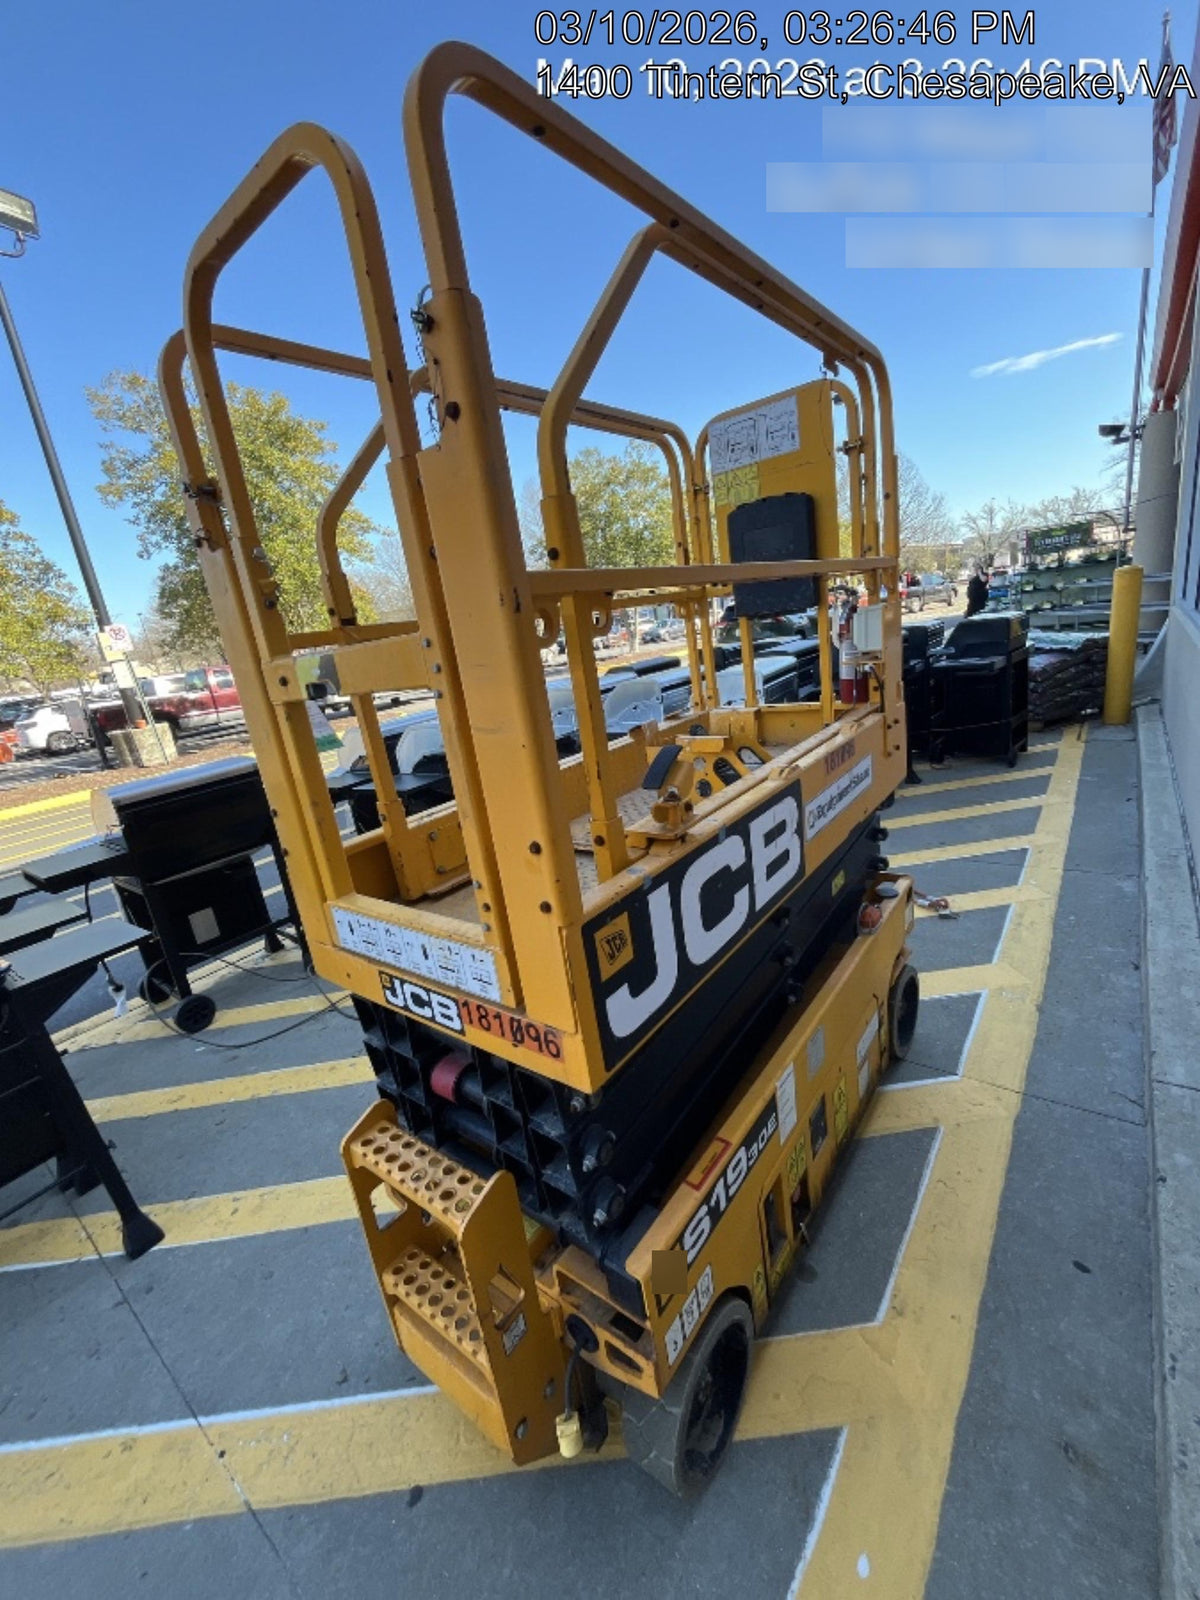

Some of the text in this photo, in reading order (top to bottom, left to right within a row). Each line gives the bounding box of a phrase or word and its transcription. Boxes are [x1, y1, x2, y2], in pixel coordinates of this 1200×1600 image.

[606, 796, 801, 1038] JCB
[385, 977, 463, 1032] JCB
[461, 1000, 561, 1059] 181096
